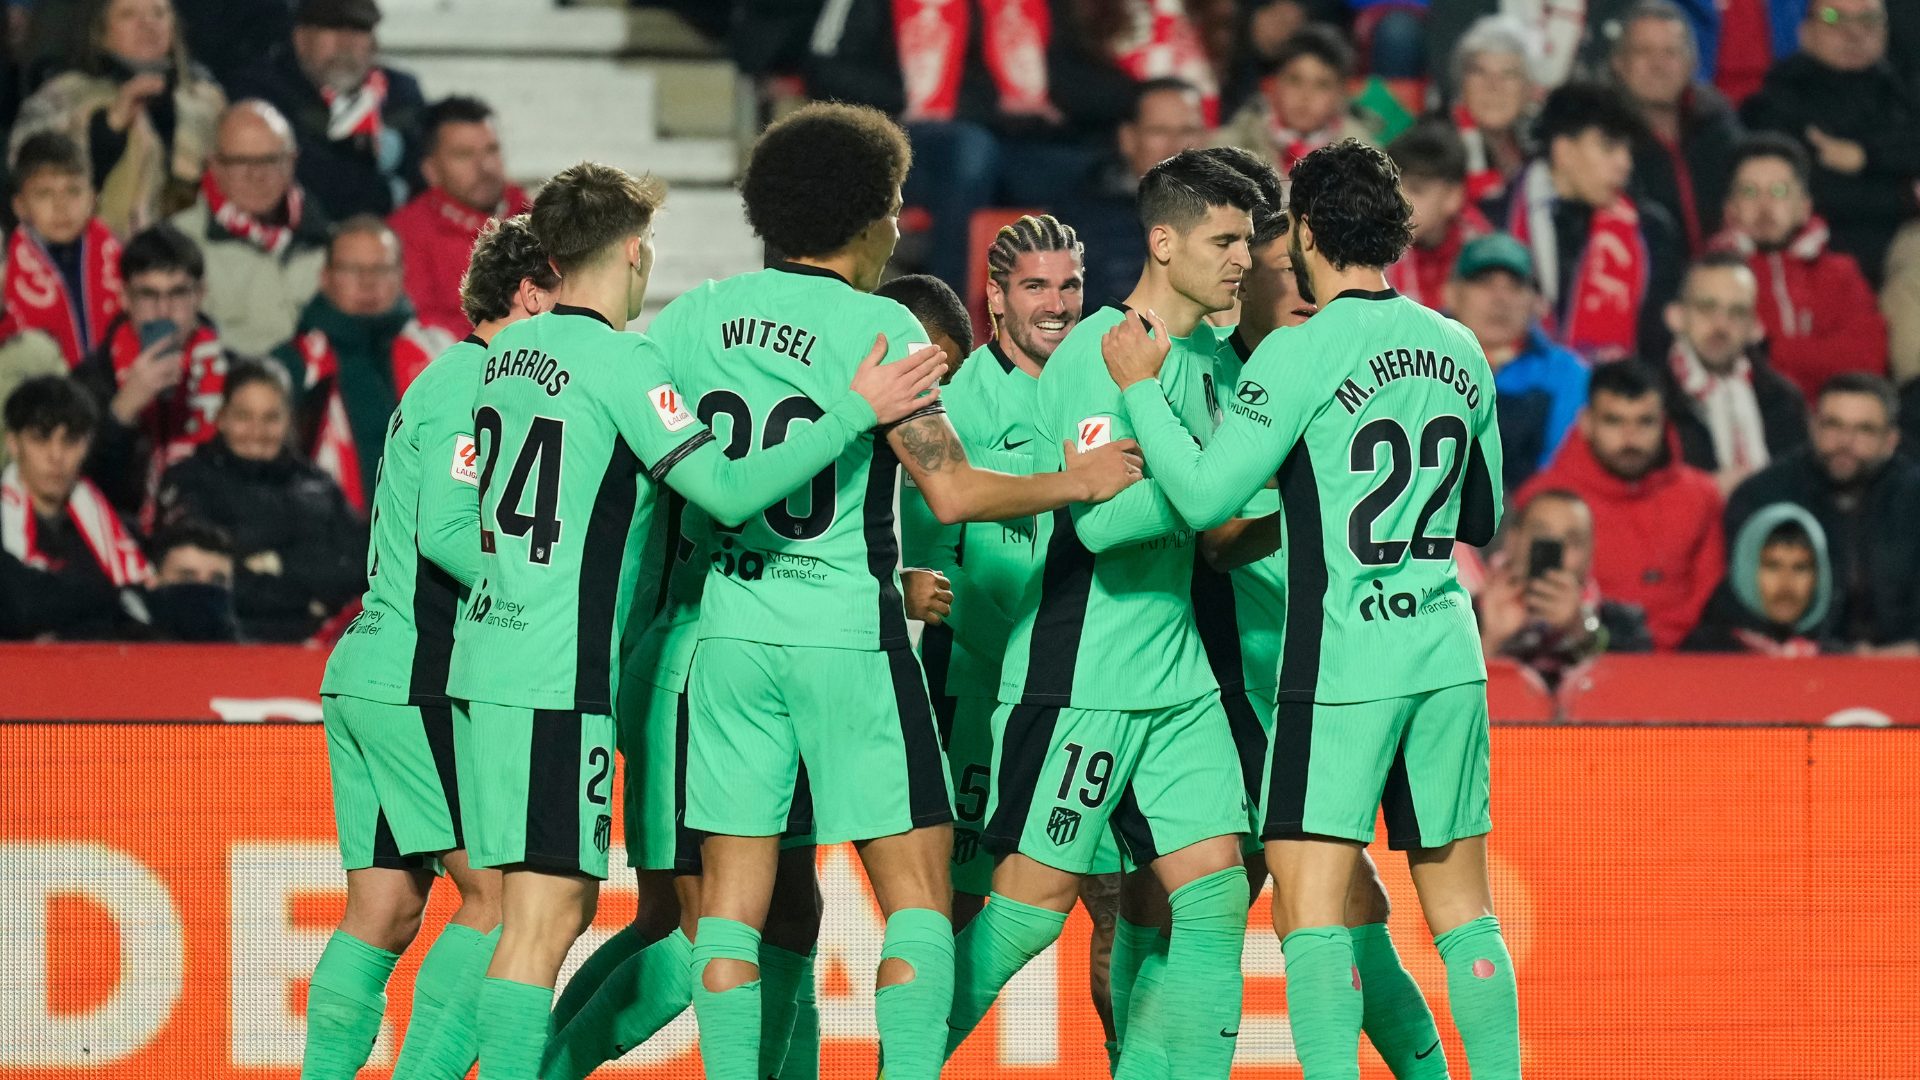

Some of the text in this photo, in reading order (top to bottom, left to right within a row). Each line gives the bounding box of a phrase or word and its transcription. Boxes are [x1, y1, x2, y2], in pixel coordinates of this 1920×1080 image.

[721, 317, 817, 367] WITSEL
[484, 348, 570, 397] BARRIOS
[1334, 348, 1480, 415] M. HERMOSO
[474, 406, 565, 565] 24
[1348, 415, 1468, 566] 22
[767, 552, 818, 570] Money
[769, 566, 828, 581] Transfer
[1359, 579, 1417, 622] ria
[956, 762, 991, 823] 5
[1056, 742, 1115, 809] 19
